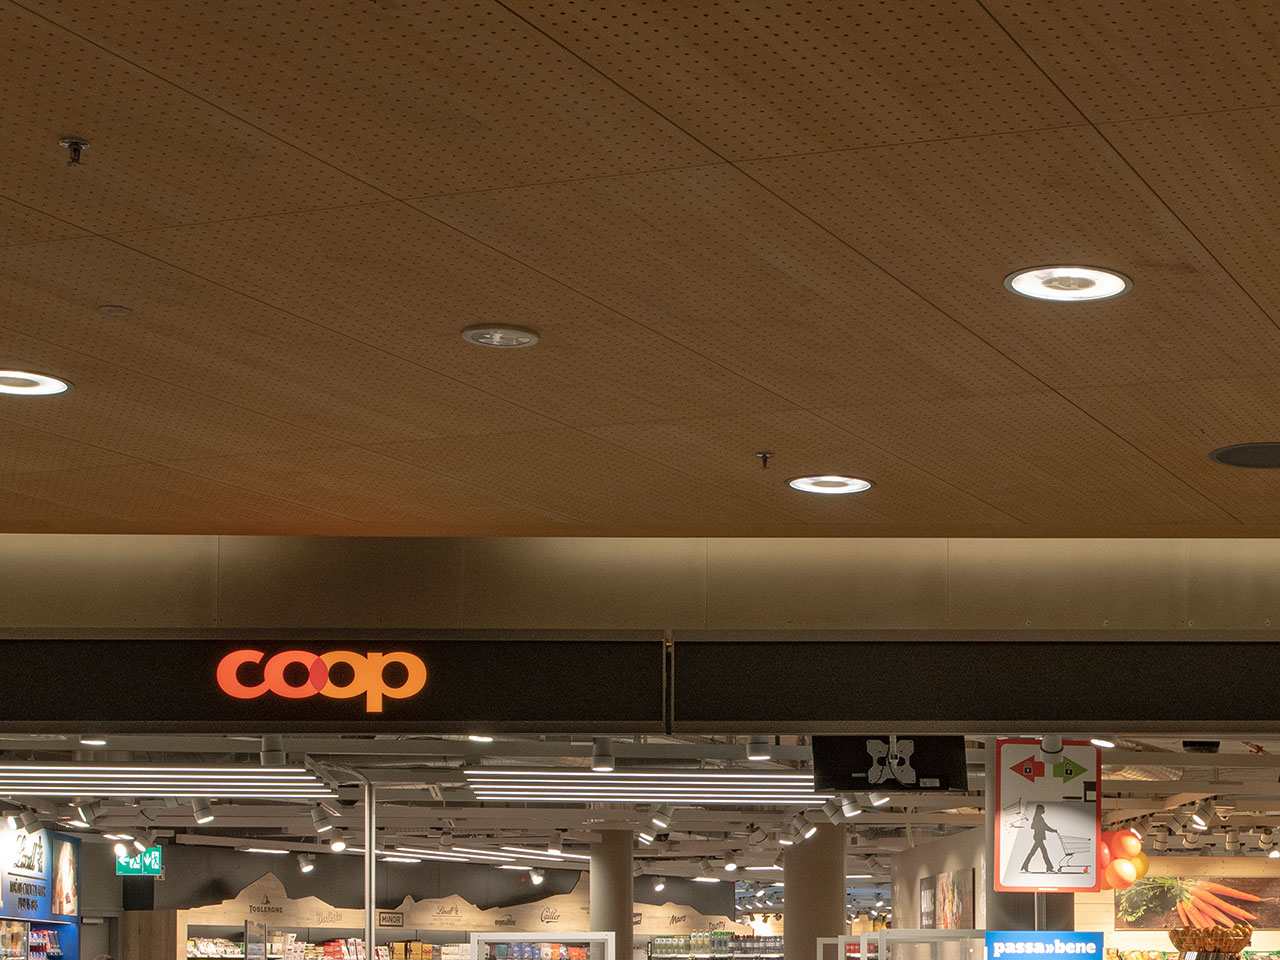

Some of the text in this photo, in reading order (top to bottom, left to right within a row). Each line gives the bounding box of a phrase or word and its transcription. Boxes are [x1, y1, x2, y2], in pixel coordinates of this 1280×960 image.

[216, 649, 427, 713] coop
[249, 905, 283, 914] TOBLERONE
[541, 907, 560, 923] Cailler
[670, 915, 687, 925] Mars
